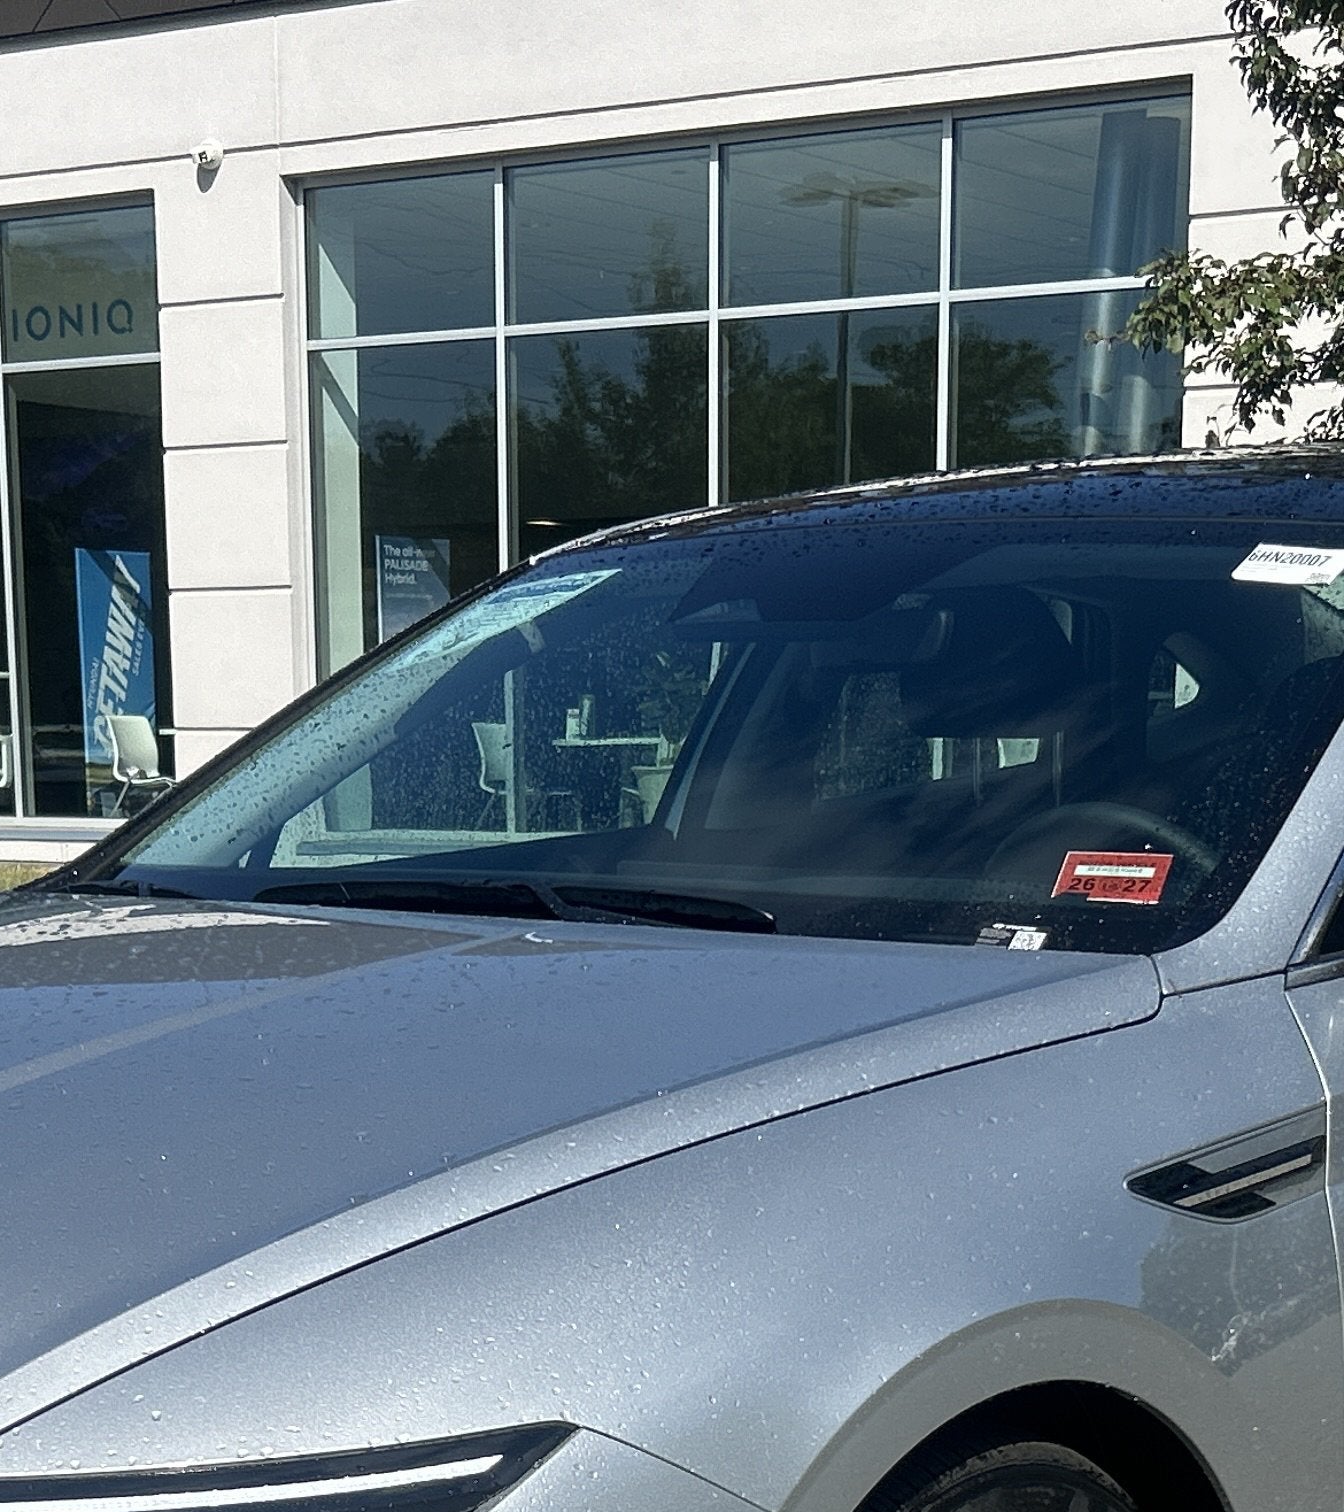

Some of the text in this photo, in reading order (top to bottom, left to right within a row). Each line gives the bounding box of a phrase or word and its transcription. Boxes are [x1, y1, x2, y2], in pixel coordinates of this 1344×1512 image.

[12, 298, 134, 342] IONIQ
[383, 544, 401, 556] The
[384, 558, 430, 572] PALISADE
[1067, 877, 1096, 891] 26
[1122, 879, 1152, 893] 27
